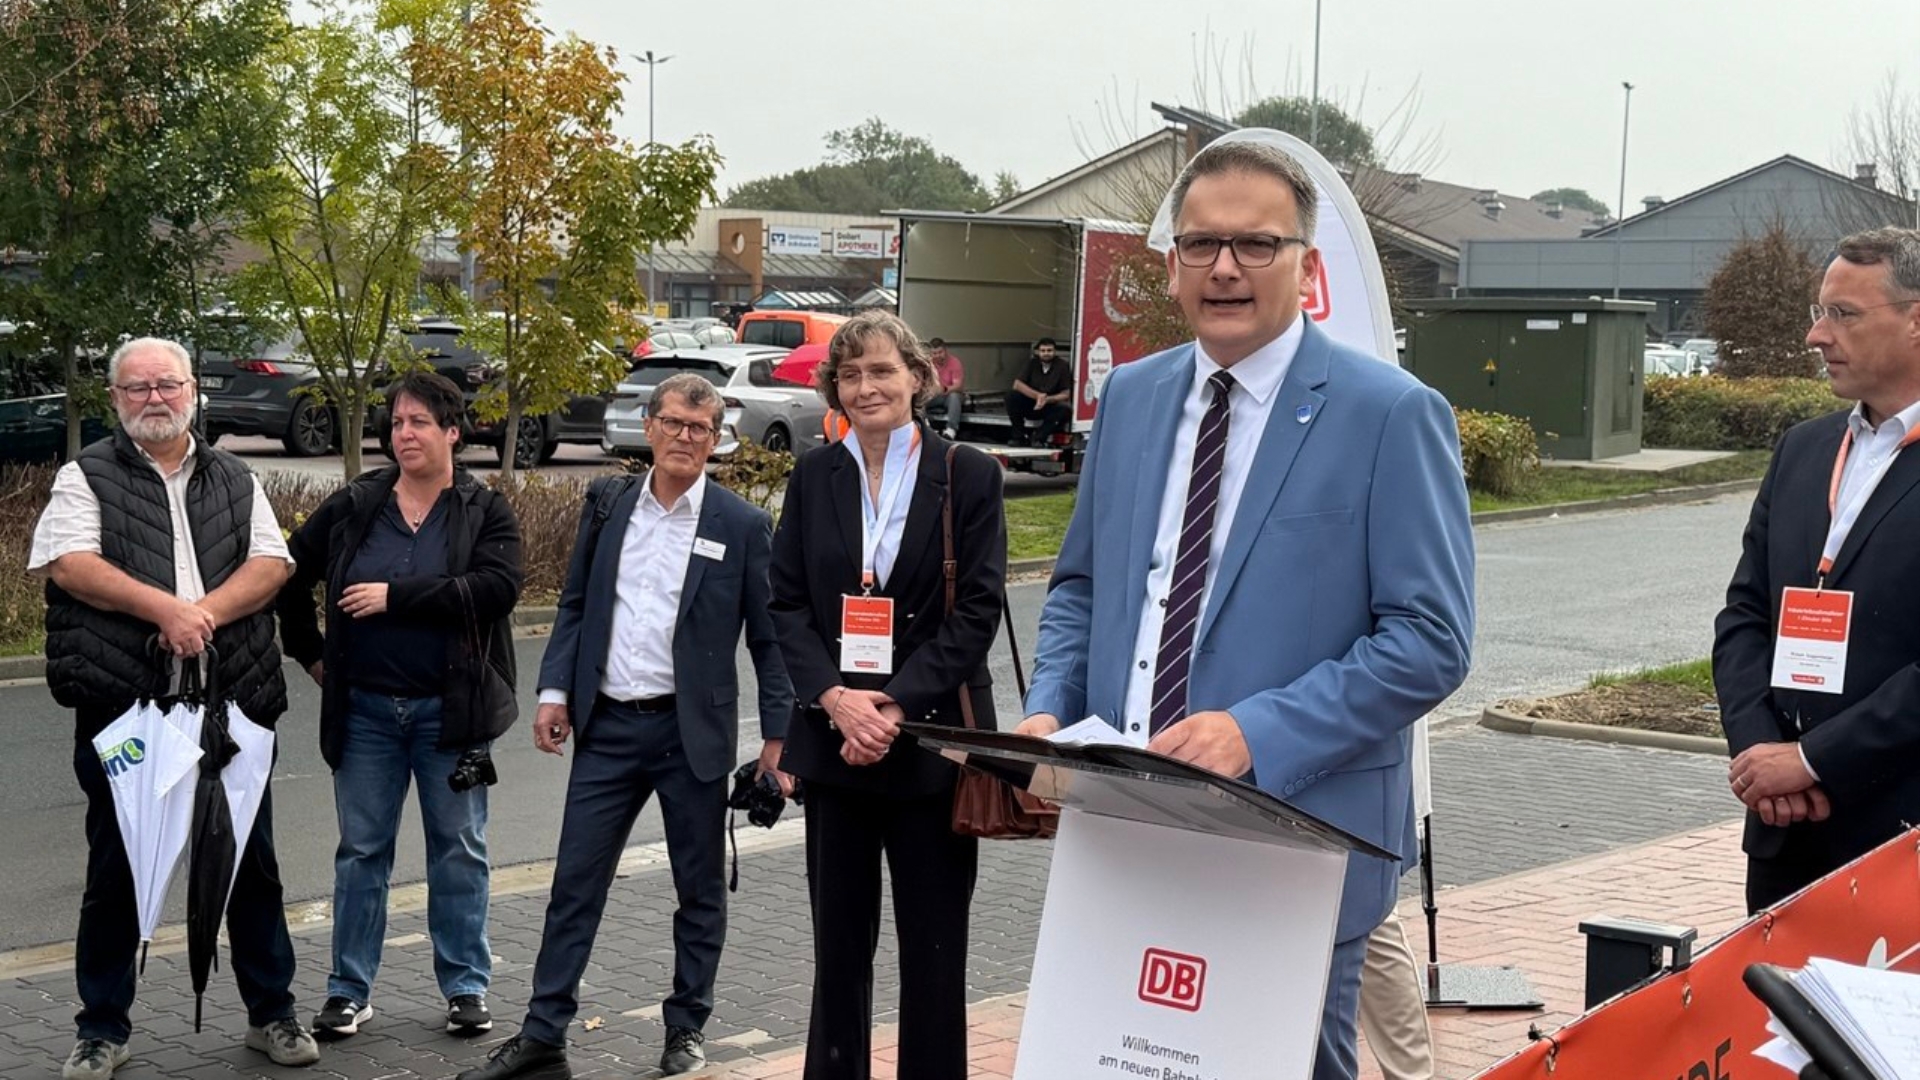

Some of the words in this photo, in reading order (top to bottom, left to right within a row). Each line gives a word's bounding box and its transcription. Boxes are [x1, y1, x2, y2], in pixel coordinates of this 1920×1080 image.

[838, 242, 879, 251] APOTHEKE
[1147, 957, 1197, 1001] DB
[1122, 1034, 1200, 1066] Willkommen
[1098, 1054, 1118, 1070] am
[1120, 1059, 1160, 1079] neuen
